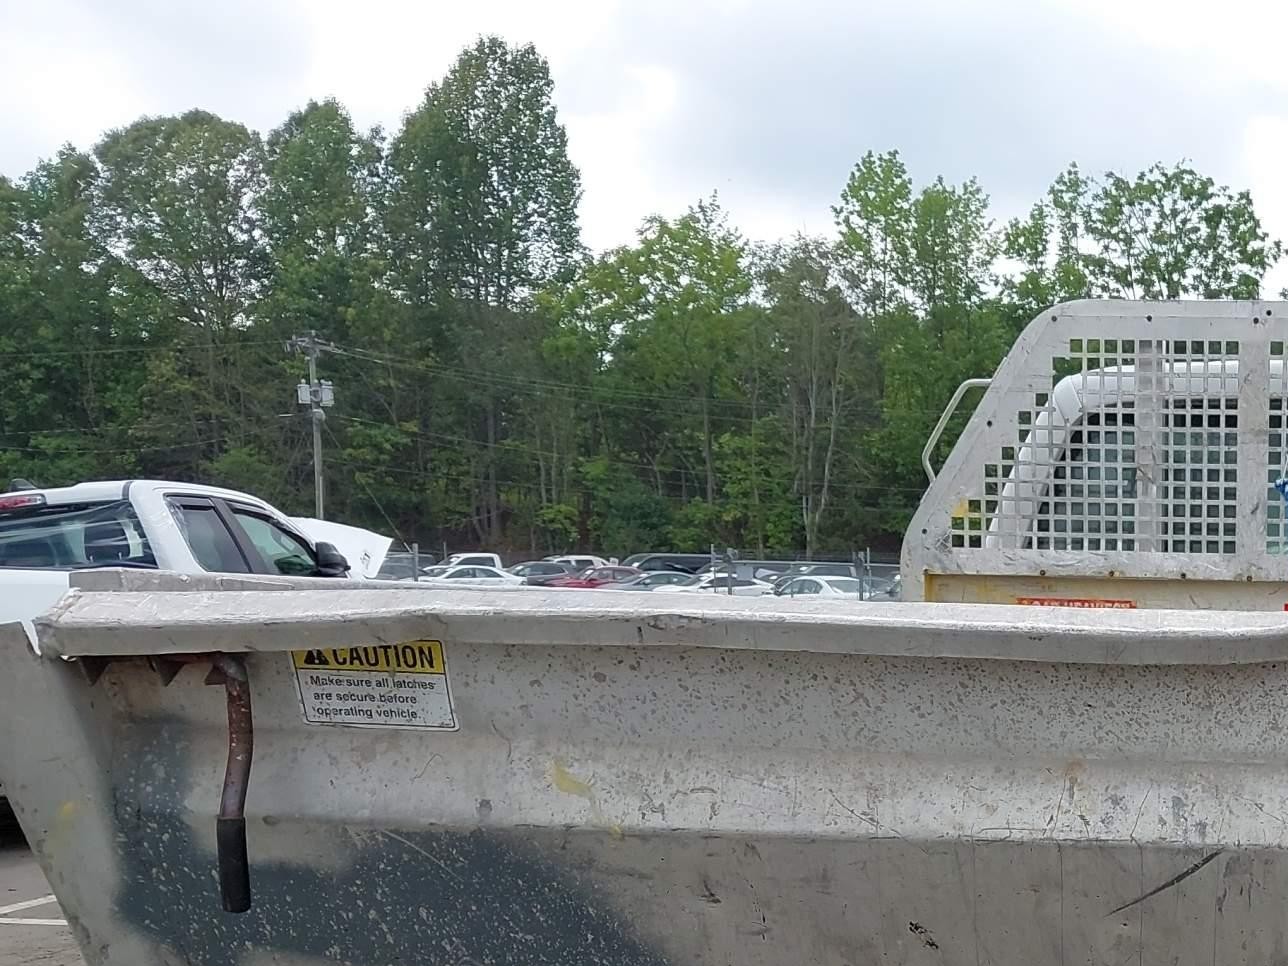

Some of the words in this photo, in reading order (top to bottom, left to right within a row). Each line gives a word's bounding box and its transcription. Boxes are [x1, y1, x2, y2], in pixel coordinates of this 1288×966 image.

[332, 645, 435, 669] CAUTION
[310, 676, 345, 687] Make
[346, 678, 372, 688] sure
[375, 677, 389, 689] all
[392, 679, 435, 691] latches
[313, 692, 333, 701] are
[335, 692, 376, 703] secure
[379, 693, 417, 704] before
[316, 706, 373, 720] operating
